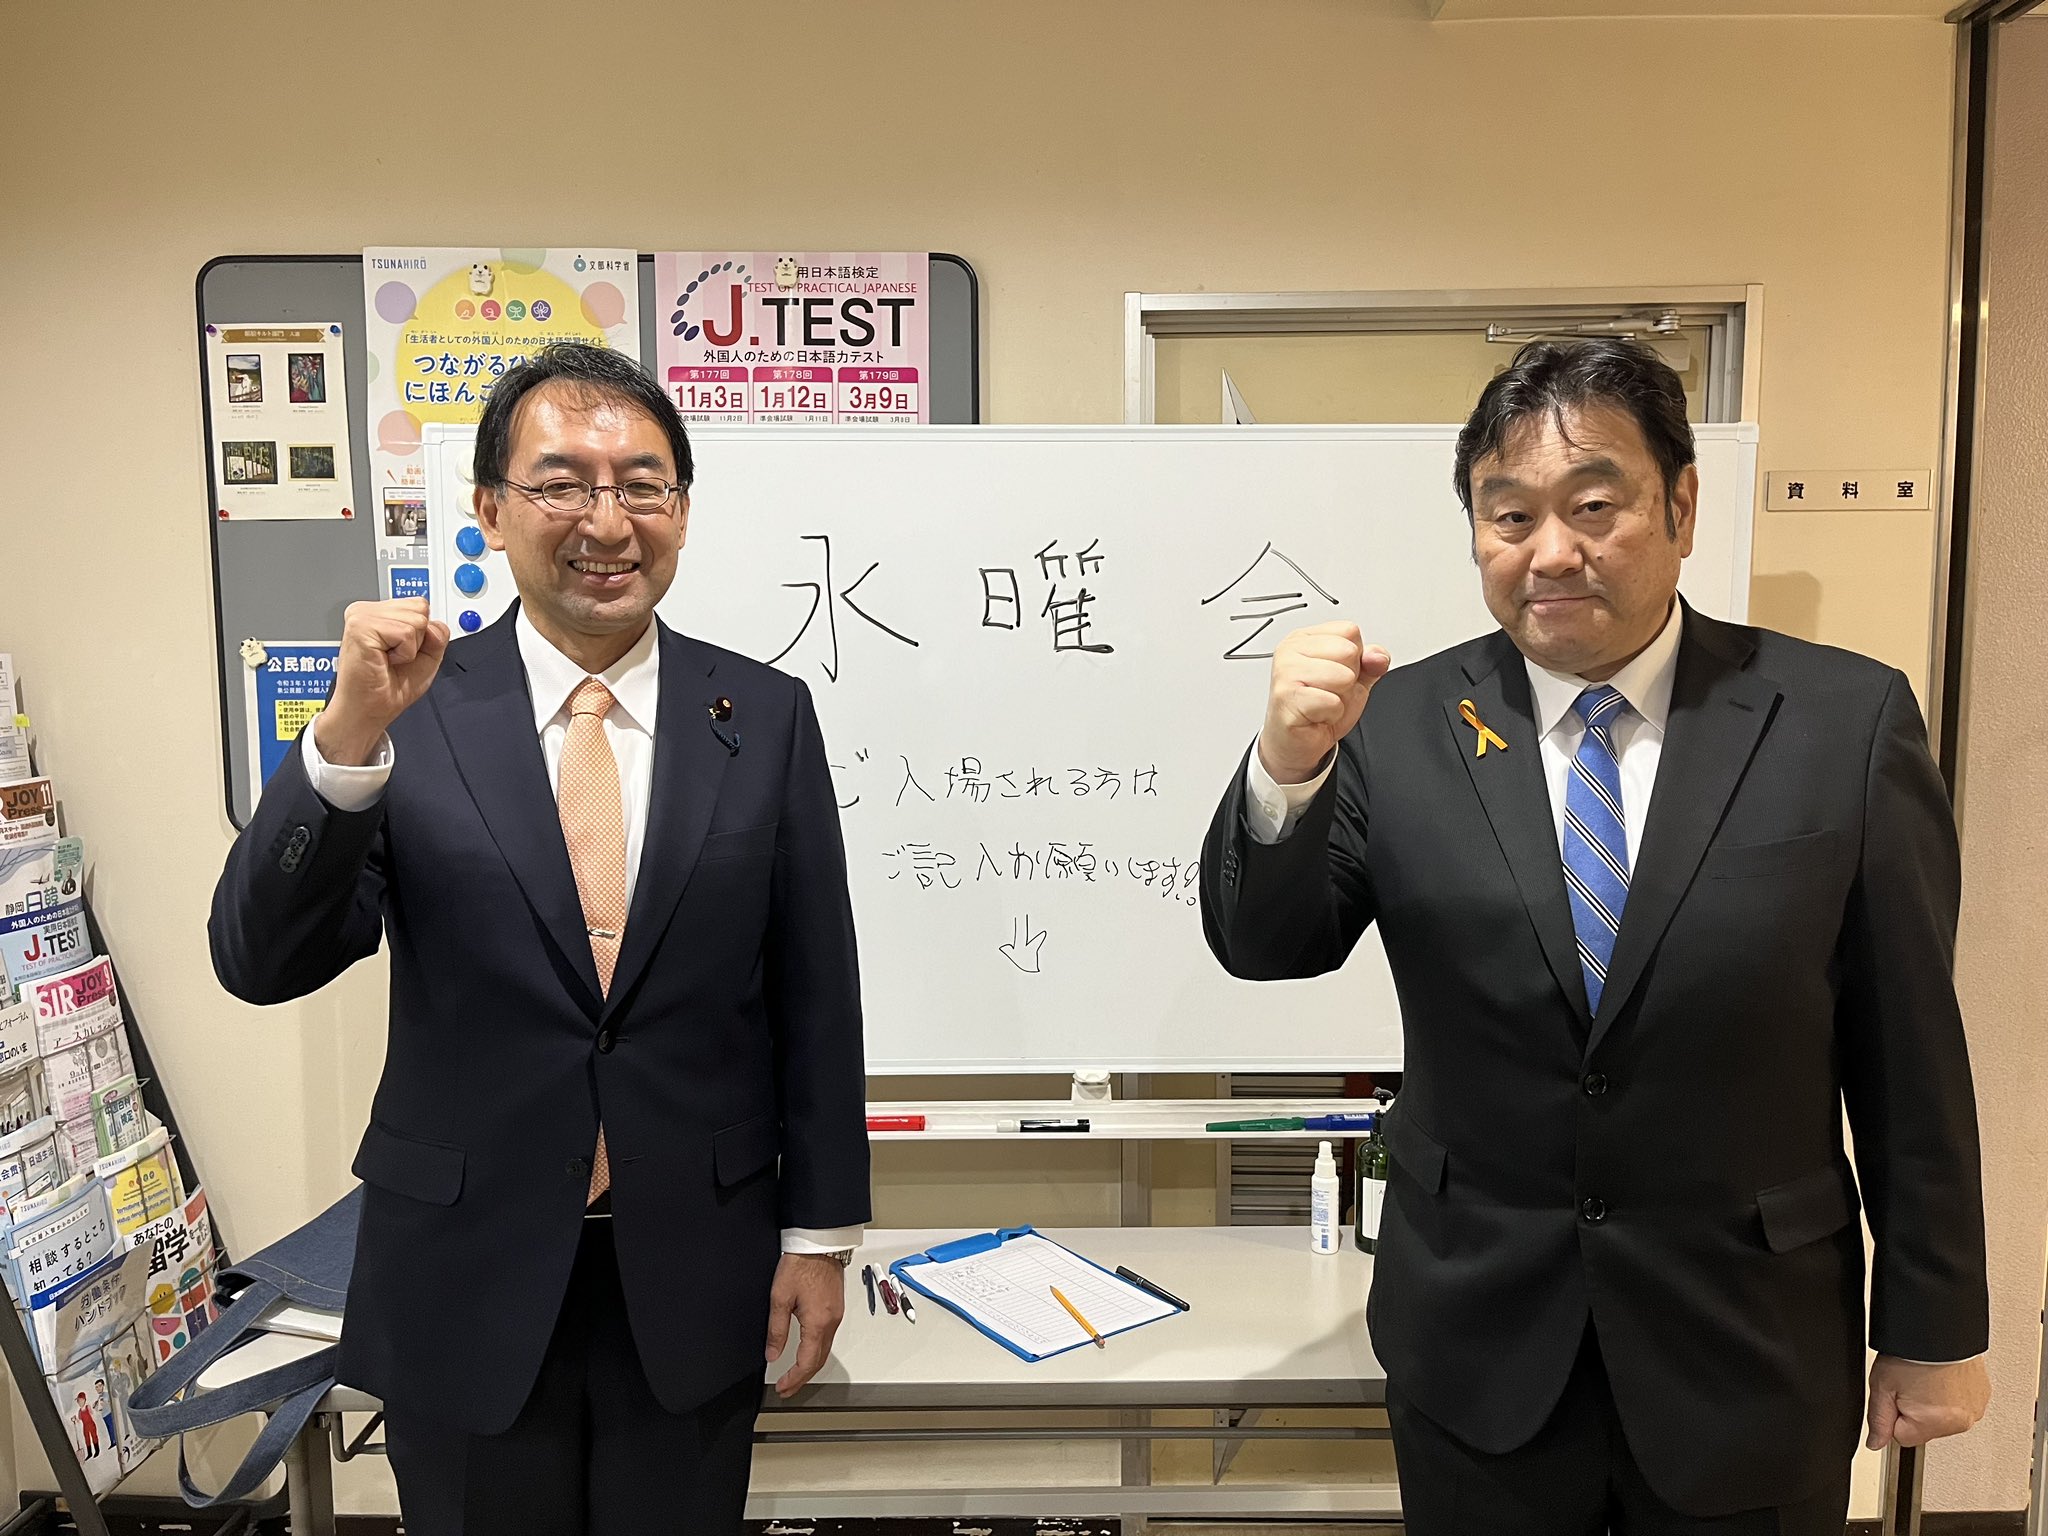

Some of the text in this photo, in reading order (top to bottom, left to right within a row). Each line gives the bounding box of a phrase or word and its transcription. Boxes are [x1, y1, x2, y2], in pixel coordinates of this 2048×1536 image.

[797, 266, 879, 279] 用日本語検定
[748, 283, 774, 293] TEST
[797, 283, 860, 293] PRACTICAL
[862, 283, 917, 294] JAPANESE
[689, 369, 730, 380] 第177回
[772, 370, 813, 380] 第178回
[858, 370, 899, 381] 第179回
[675, 385, 743, 408] 11月3日
[760, 386, 827, 409] 1月12日
[849, 386, 908, 410] 3月9日
[681, 414, 710, 422] 会場試験
[6, 788, 39, 808] JOY
[7, 805, 44, 820] Press
[23, 927, 81, 962] J.TEST
[37, 983, 78, 1018] SIR
[75, 972, 102, 995] JOY
[77, 988, 107, 1007] Press
[133, 1216, 174, 1246] あなたの
[28, 1218, 106, 1276] 相談するところ
